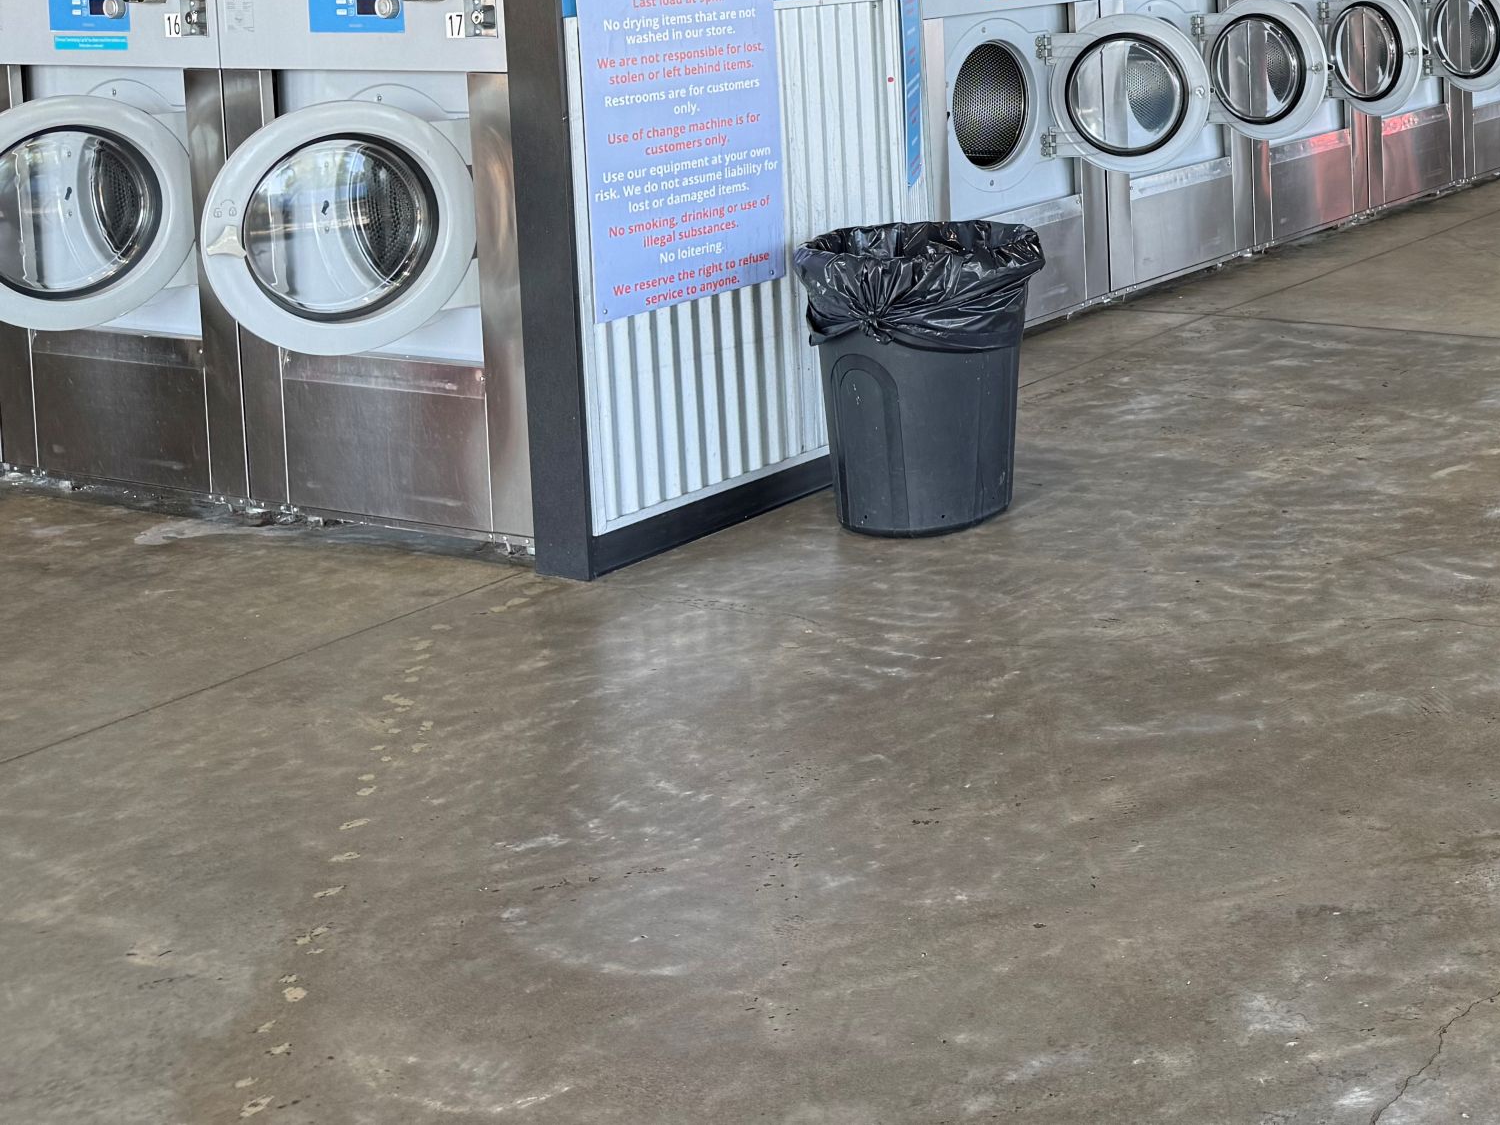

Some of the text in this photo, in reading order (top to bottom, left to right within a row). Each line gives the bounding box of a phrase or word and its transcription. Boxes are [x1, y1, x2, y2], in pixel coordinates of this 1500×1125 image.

[168, 15, 180, 35] 16
[448, 15, 463, 36] 17
[603, 9, 756, 32] No drying items that are not
[626, 24, 736, 44] washed in our store.
[597, 58, 615, 69] We
[619, 58, 637, 67] are
[641, 54, 659, 65] not
[663, 44, 724, 62] responsible
[726, 42, 741, 54] for
[609, 59, 754, 85] stolen or left behind items.
[605, 77, 760, 107] Restrooms are for customers
[674, 103, 700, 116] only.
[608, 112, 760, 145] Use of change machine is for
[645, 133, 730, 156] customers only.
[603, 146, 771, 183] Use our equipment at your own
[595, 159, 778, 203] risk. We do not assume liability for
[628, 183, 749, 213] lost or damaged items.
[609, 195, 770, 238] No smoking, drinking or use of
[643, 220, 738, 247] illegal substances.
[660, 241, 724, 263] No loitering.
[613, 251, 769, 296] We reserve the right to refuse
[646, 275, 740, 305] service to anyone.
